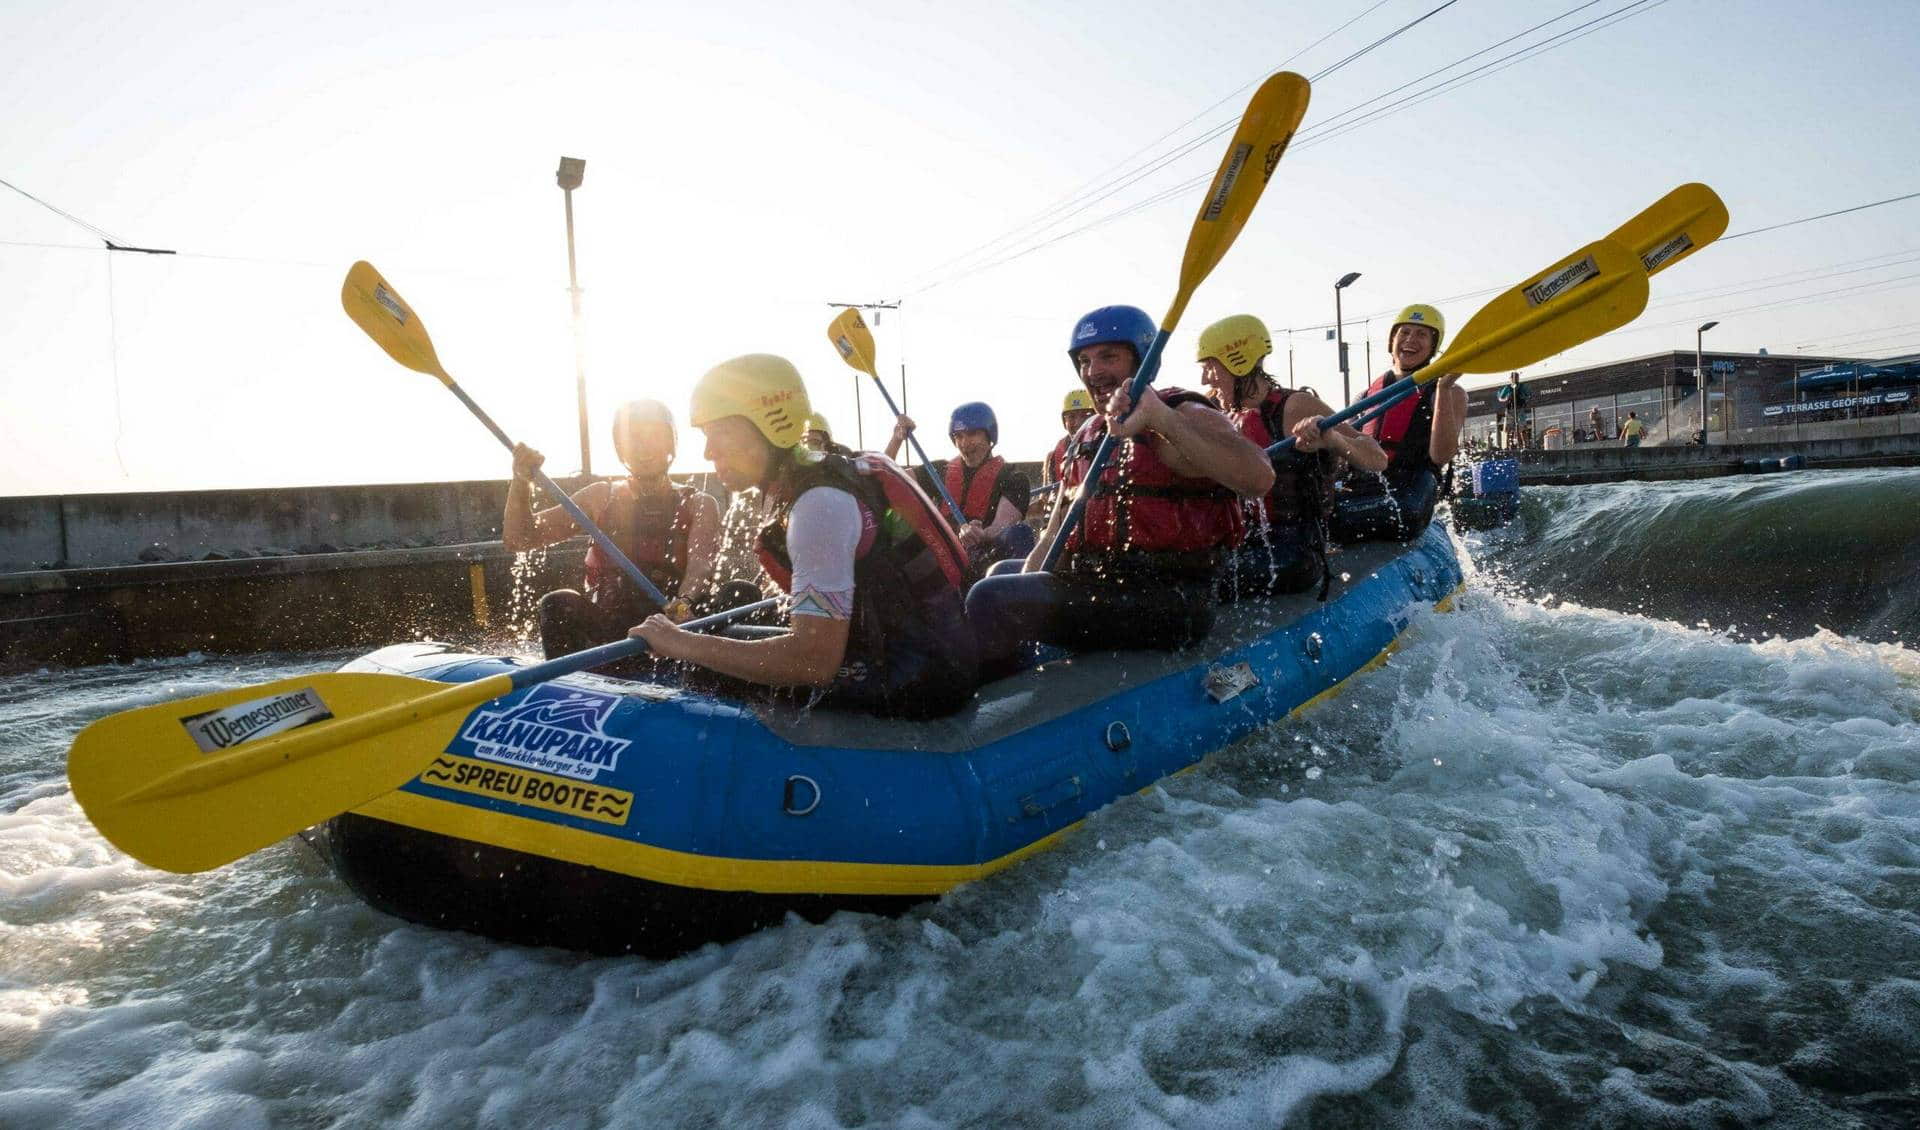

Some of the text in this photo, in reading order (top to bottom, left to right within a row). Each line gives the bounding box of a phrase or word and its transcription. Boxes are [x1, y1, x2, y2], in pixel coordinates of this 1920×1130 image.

[1529, 260, 1589, 304] Wernesgrüner
[1786, 401, 1830, 412] TERRASSE
[200, 692, 312, 748] Wernesgrüner
[465, 714, 628, 767] KANUPARK
[478, 744, 593, 776] am Markkleeberger See
[453, 764, 599, 812] SPREU BOOTE
